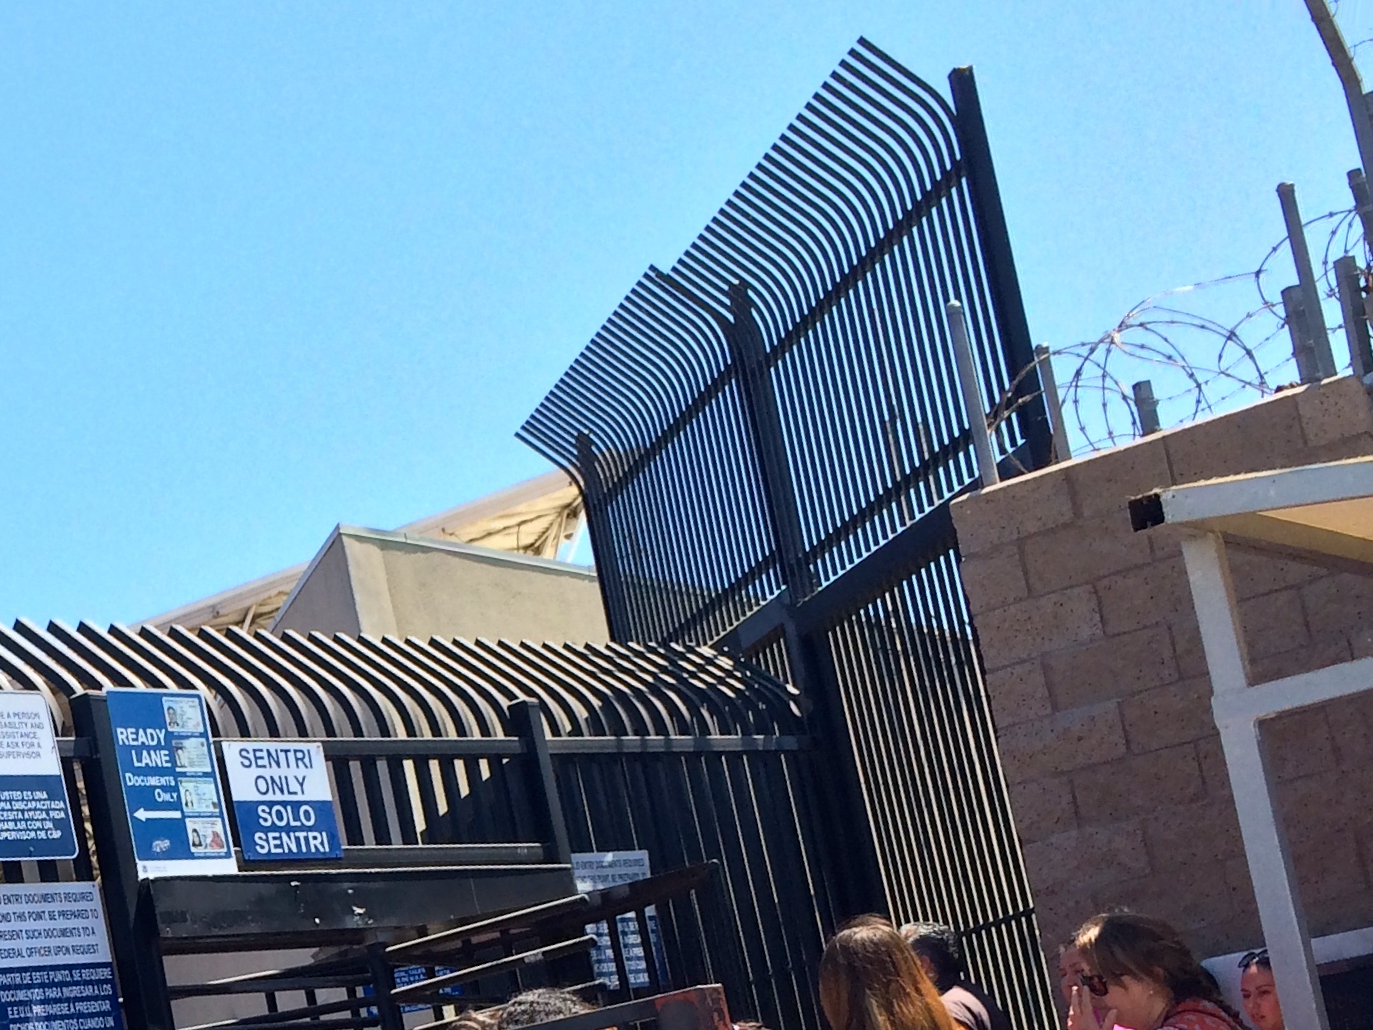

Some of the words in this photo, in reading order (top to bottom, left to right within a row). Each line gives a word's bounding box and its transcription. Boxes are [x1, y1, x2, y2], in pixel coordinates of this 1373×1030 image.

[13, 711, 41, 720] PERSON
[30, 721, 44, 730] AND
[116, 727, 166, 746] READY
[6, 741, 20, 750] ASK
[21, 741, 36, 750] FOR
[131, 750, 172, 768] LANE
[238, 748, 313, 769] SENTRI
[254, 775, 307, 796] ONLY
[0, 791, 23, 800] USTED
[23, 791, 33, 799] ES
[33, 791, 48, 799] UNA
[12, 801, 66, 810] DISCAPACITADA
[49, 811, 66, 819] PIDA
[257, 804, 316, 827] SOLO
[27, 821, 42, 830] CON
[37, 830, 47, 839] DE
[47, 830, 62, 839] CBP
[254, 831, 330, 854] SENTRI
[3, 893, 23, 905] ENTRY
[24, 892, 62, 904] DOCUMENTS
[63, 891, 94, 903] REQUIRED
[12, 911, 27, 922] THIS
[47, 910, 57, 921] BE
[57, 909, 89, 920] PREPARED
[89, 908, 99, 919] TO
[25, 928, 42, 940] SUCH
[43, 927, 81, 939] DOCUMENTS
[81, 926, 91, 937] TO
[26, 945, 52, 957] OFFICER
[53, 945, 70, 956] UPON
[71, 944, 99, 955] REQUEST
[22, 972, 32, 984] DE
[32, 971, 49, 983] ESTE
[72, 969, 81, 981] SE
[81, 968, 113, 980] REQUIERE
[0, 988, 45, 1003] DOCUMENTOS
[45, 987, 62, 999] PARA
[99, 984, 113, 996] LOS
[76, 1000, 112, 1013] PRESENTAR
[79, 1017, 105, 1030] CUANDO
